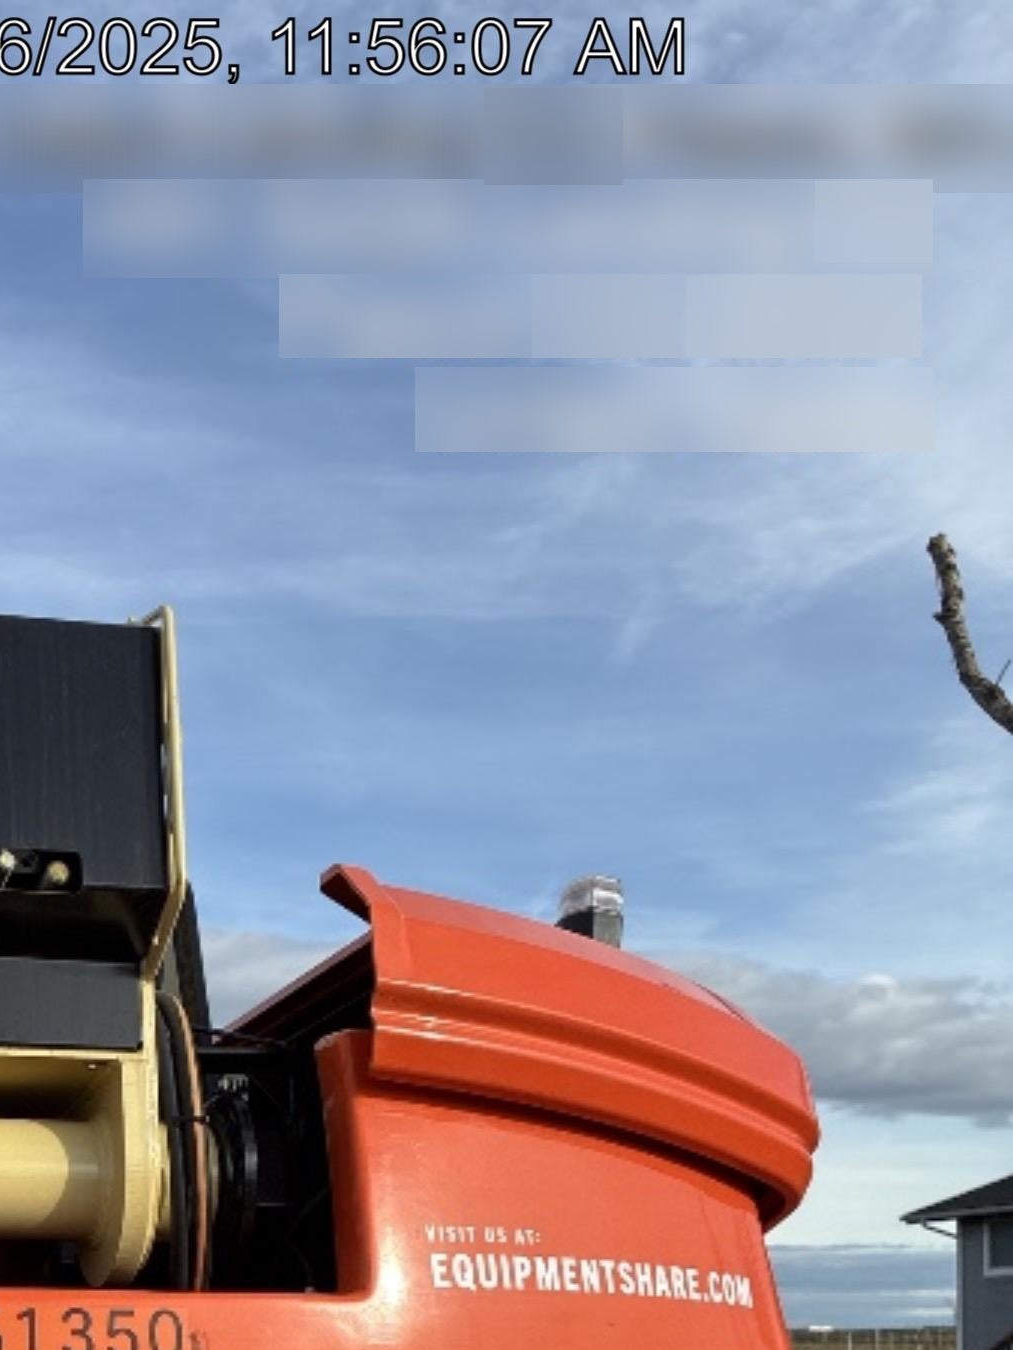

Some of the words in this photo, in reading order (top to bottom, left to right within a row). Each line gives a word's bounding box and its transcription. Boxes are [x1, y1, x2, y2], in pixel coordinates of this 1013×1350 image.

[425, 1224, 475, 1243] VISIT
[484, 1226, 507, 1243] US
[514, 1228, 541, 1246] AT:
[430, 1253, 754, 1309] EQUIPMENTSHARE.COM
